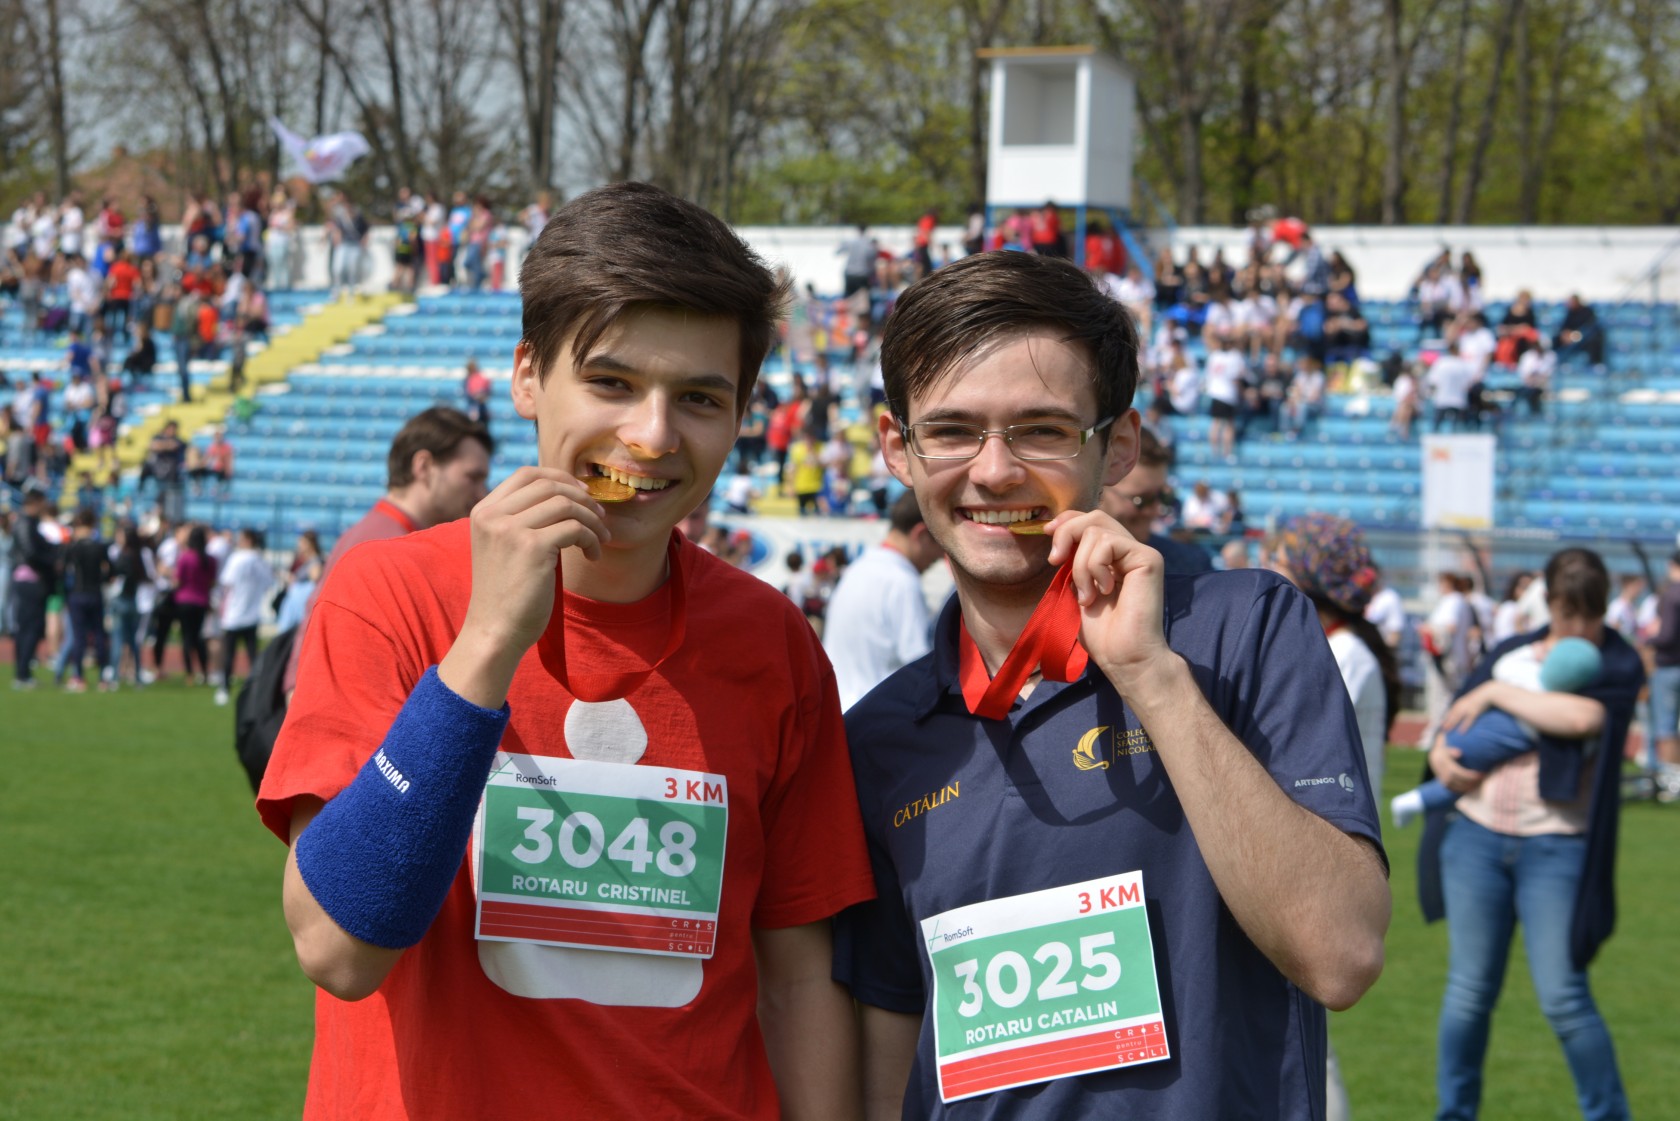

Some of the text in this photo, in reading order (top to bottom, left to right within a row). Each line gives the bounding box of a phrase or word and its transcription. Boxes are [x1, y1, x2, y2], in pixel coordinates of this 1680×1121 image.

[374, 747, 410, 793] MAXIMA
[516, 773, 557, 786] RomSoft
[1294, 777, 1335, 787] ARTENGO
[664, 778, 724, 803] 3 KM
[511, 806, 697, 877] 3048
[512, 875, 691, 905] ROTARU CRISTINEL
[1078, 882, 1141, 914] 3 KM
[944, 926, 974, 942] RomSoft
[954, 931, 1121, 1017] 3025
[966, 1001, 1118, 1045] ROTARU CATALIN
